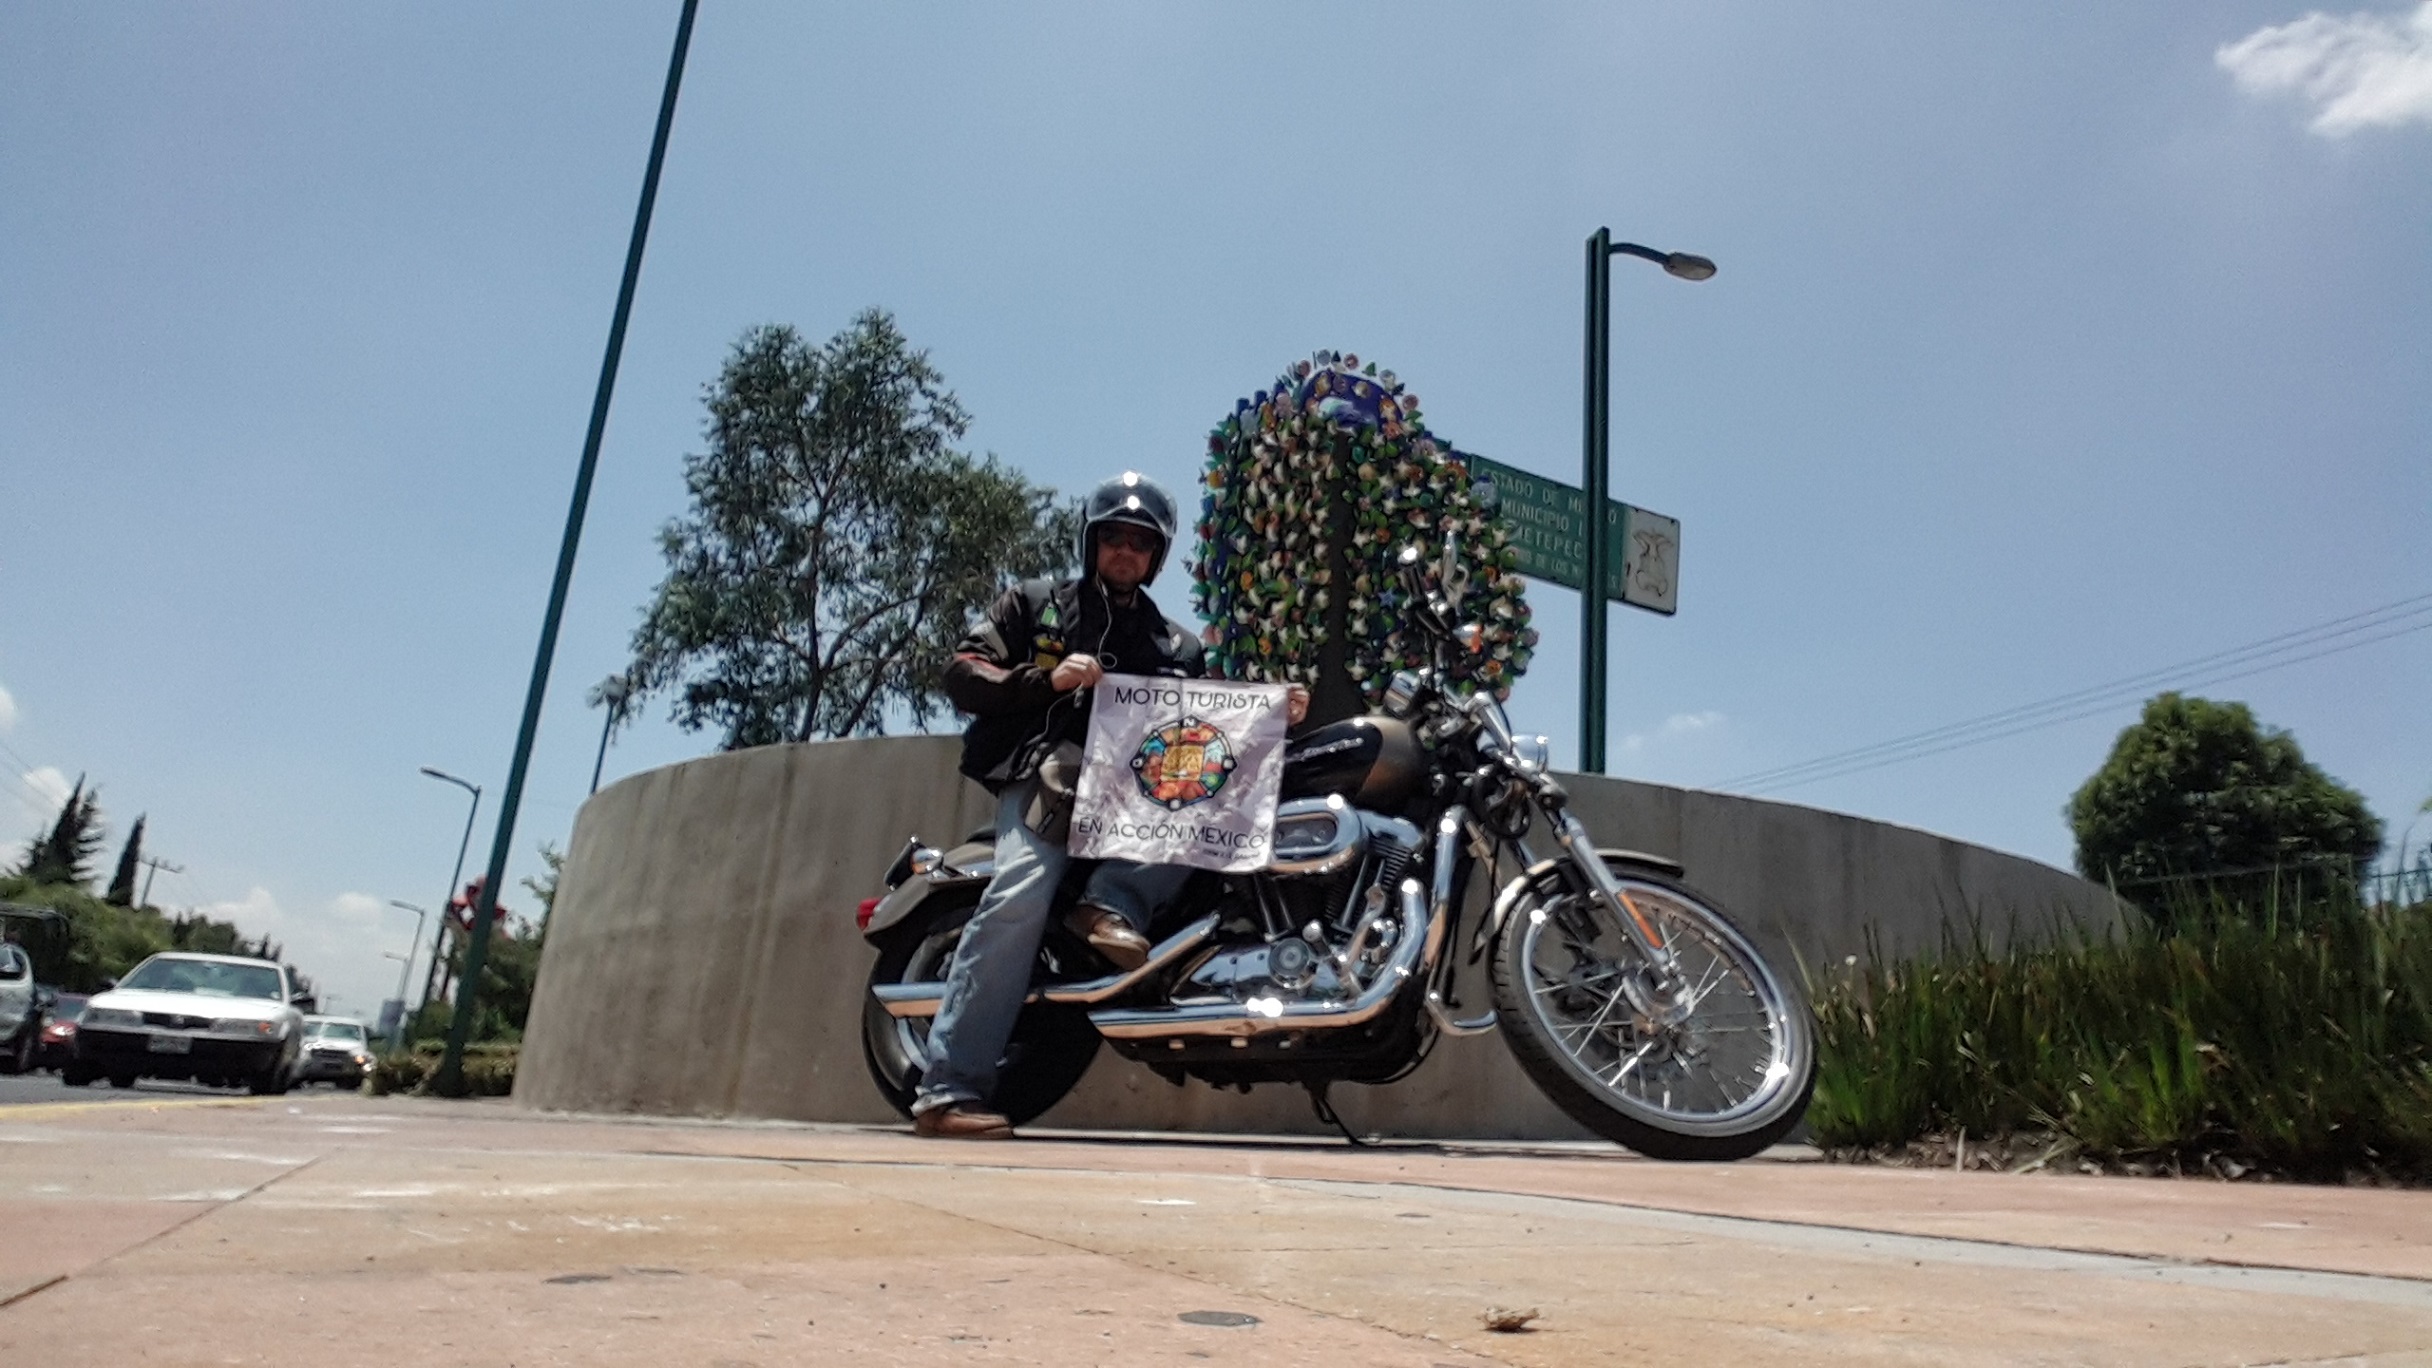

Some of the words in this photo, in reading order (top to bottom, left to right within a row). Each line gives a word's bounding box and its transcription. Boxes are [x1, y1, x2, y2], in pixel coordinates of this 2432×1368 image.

[1500, 498, 1569, 532] MUNICIPIO
[1114, 686, 1181, 706] MOTO
[1186, 691, 1271, 711] TURISTA
[1078, 816, 1102, 835] EN
